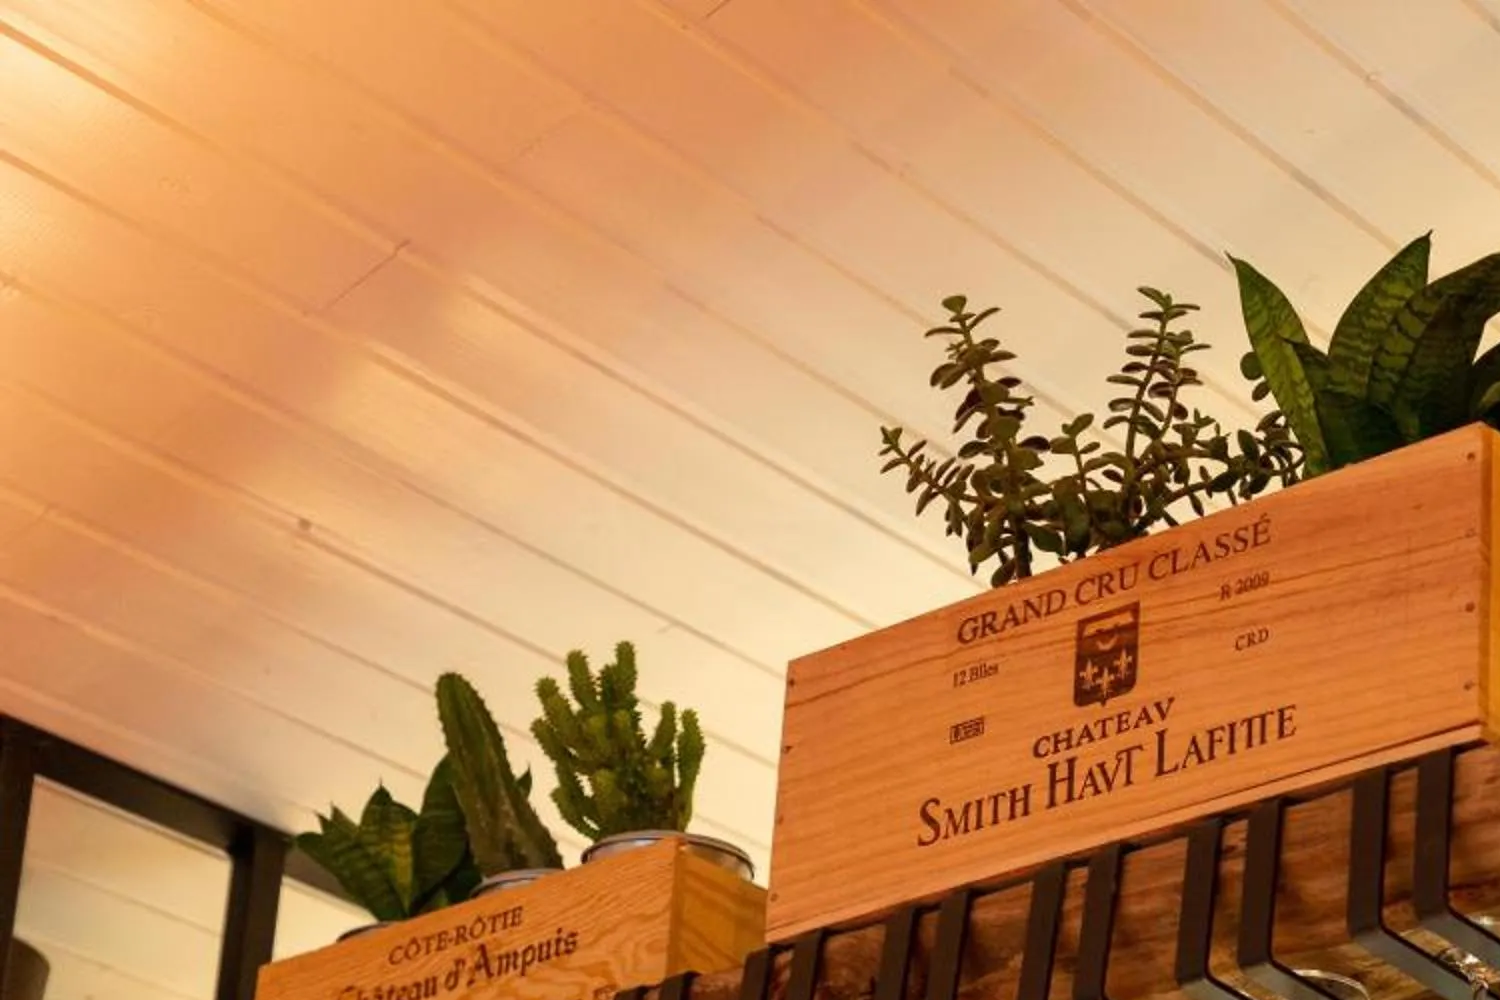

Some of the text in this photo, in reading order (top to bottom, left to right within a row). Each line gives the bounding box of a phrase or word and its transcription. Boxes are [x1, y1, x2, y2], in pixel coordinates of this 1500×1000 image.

[956, 513, 1272, 645] GRAND CRU CLASSÉ
[1234, 627, 1269, 652] CRD
[1032, 697, 1176, 760] CHATEAV
[917, 782, 1032, 848] SMITH
[1154, 704, 1298, 778] LAFITTE
[387, 905, 525, 967] CÔTE-RÔTIE
